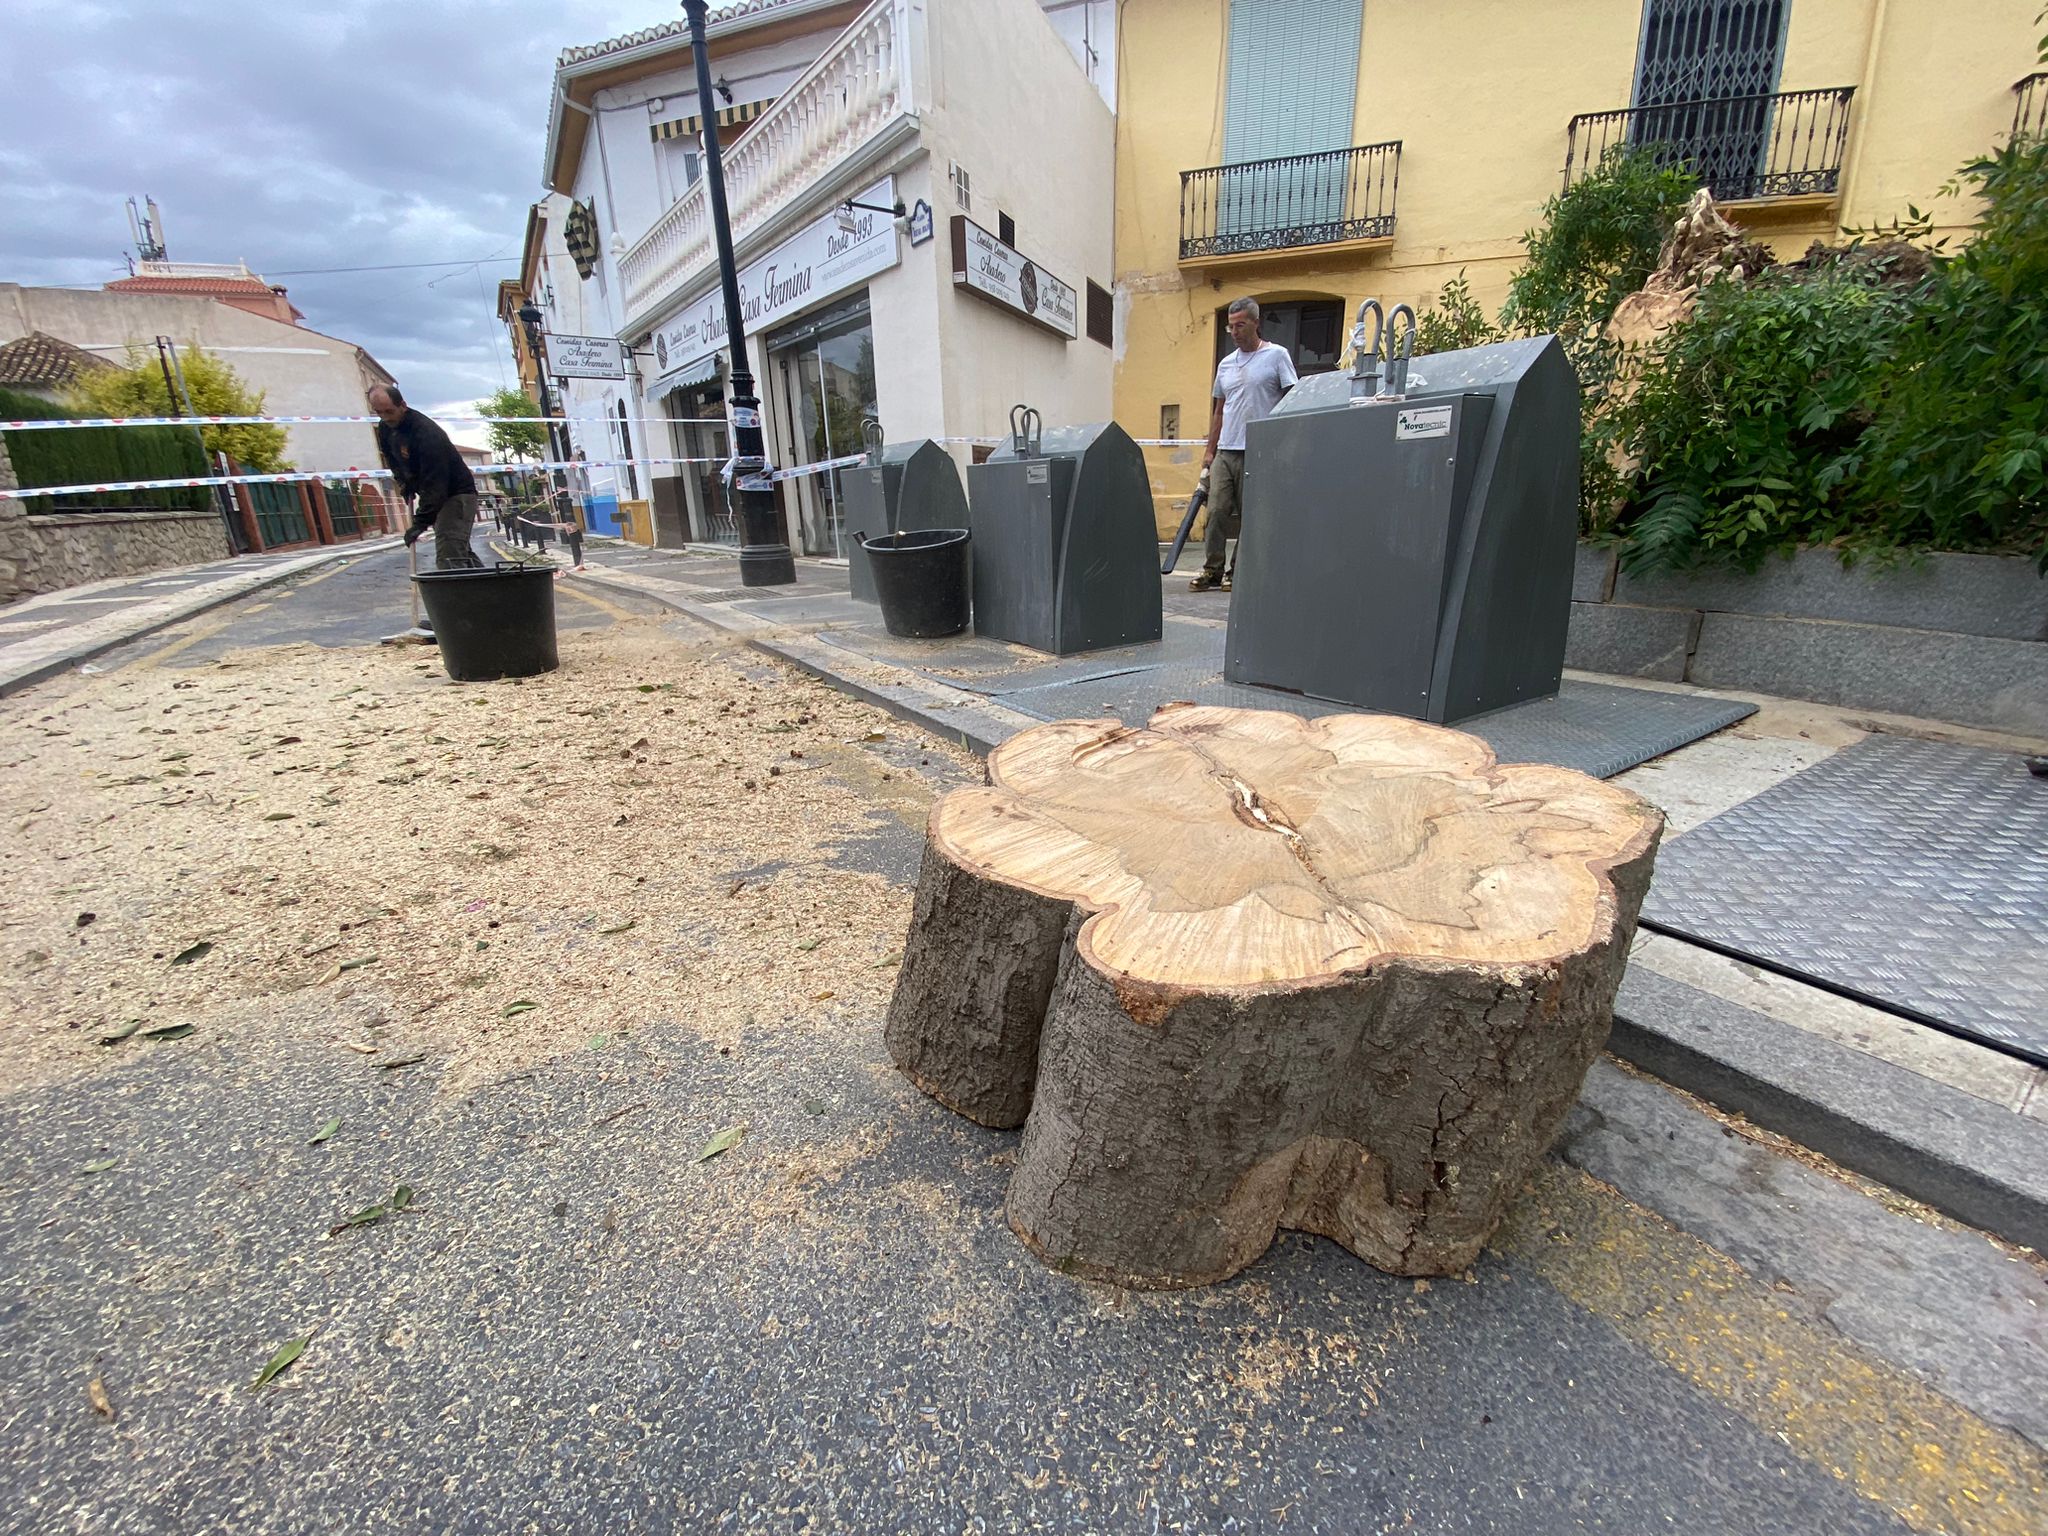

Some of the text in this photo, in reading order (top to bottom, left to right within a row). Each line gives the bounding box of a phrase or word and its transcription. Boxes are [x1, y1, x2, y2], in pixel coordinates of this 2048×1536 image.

[827, 213, 873, 257] Desde 1993
[976, 231, 1008, 260] Comidas Caseras
[980, 255, 1006, 283] Asadero
[764, 262, 811, 312] Fermina
[1042, 287, 1053, 311] Casa
[1054, 295, 1072, 321] Fermina
[556, 337, 609, 347] Comidas Caseras
[567, 346, 602, 357] Asadero
[559, 355, 613, 368] Casa Fermina
[1404, 421, 1448, 430] Novatecnic
